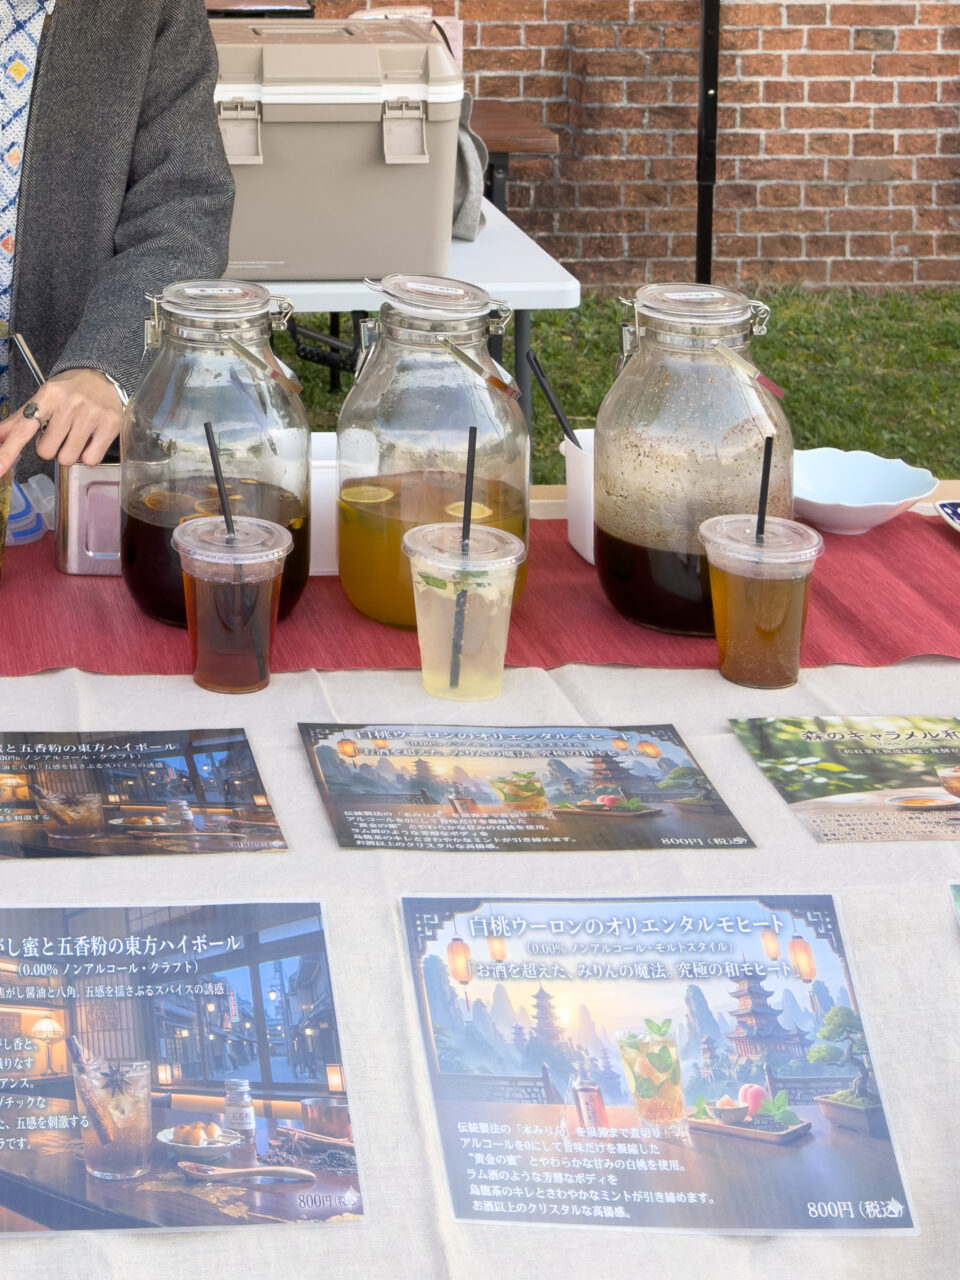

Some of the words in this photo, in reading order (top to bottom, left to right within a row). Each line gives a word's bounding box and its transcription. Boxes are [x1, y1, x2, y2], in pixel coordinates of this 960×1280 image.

[469, 914, 784, 937] 白桃ウーロンのオリエンタルモヒート
